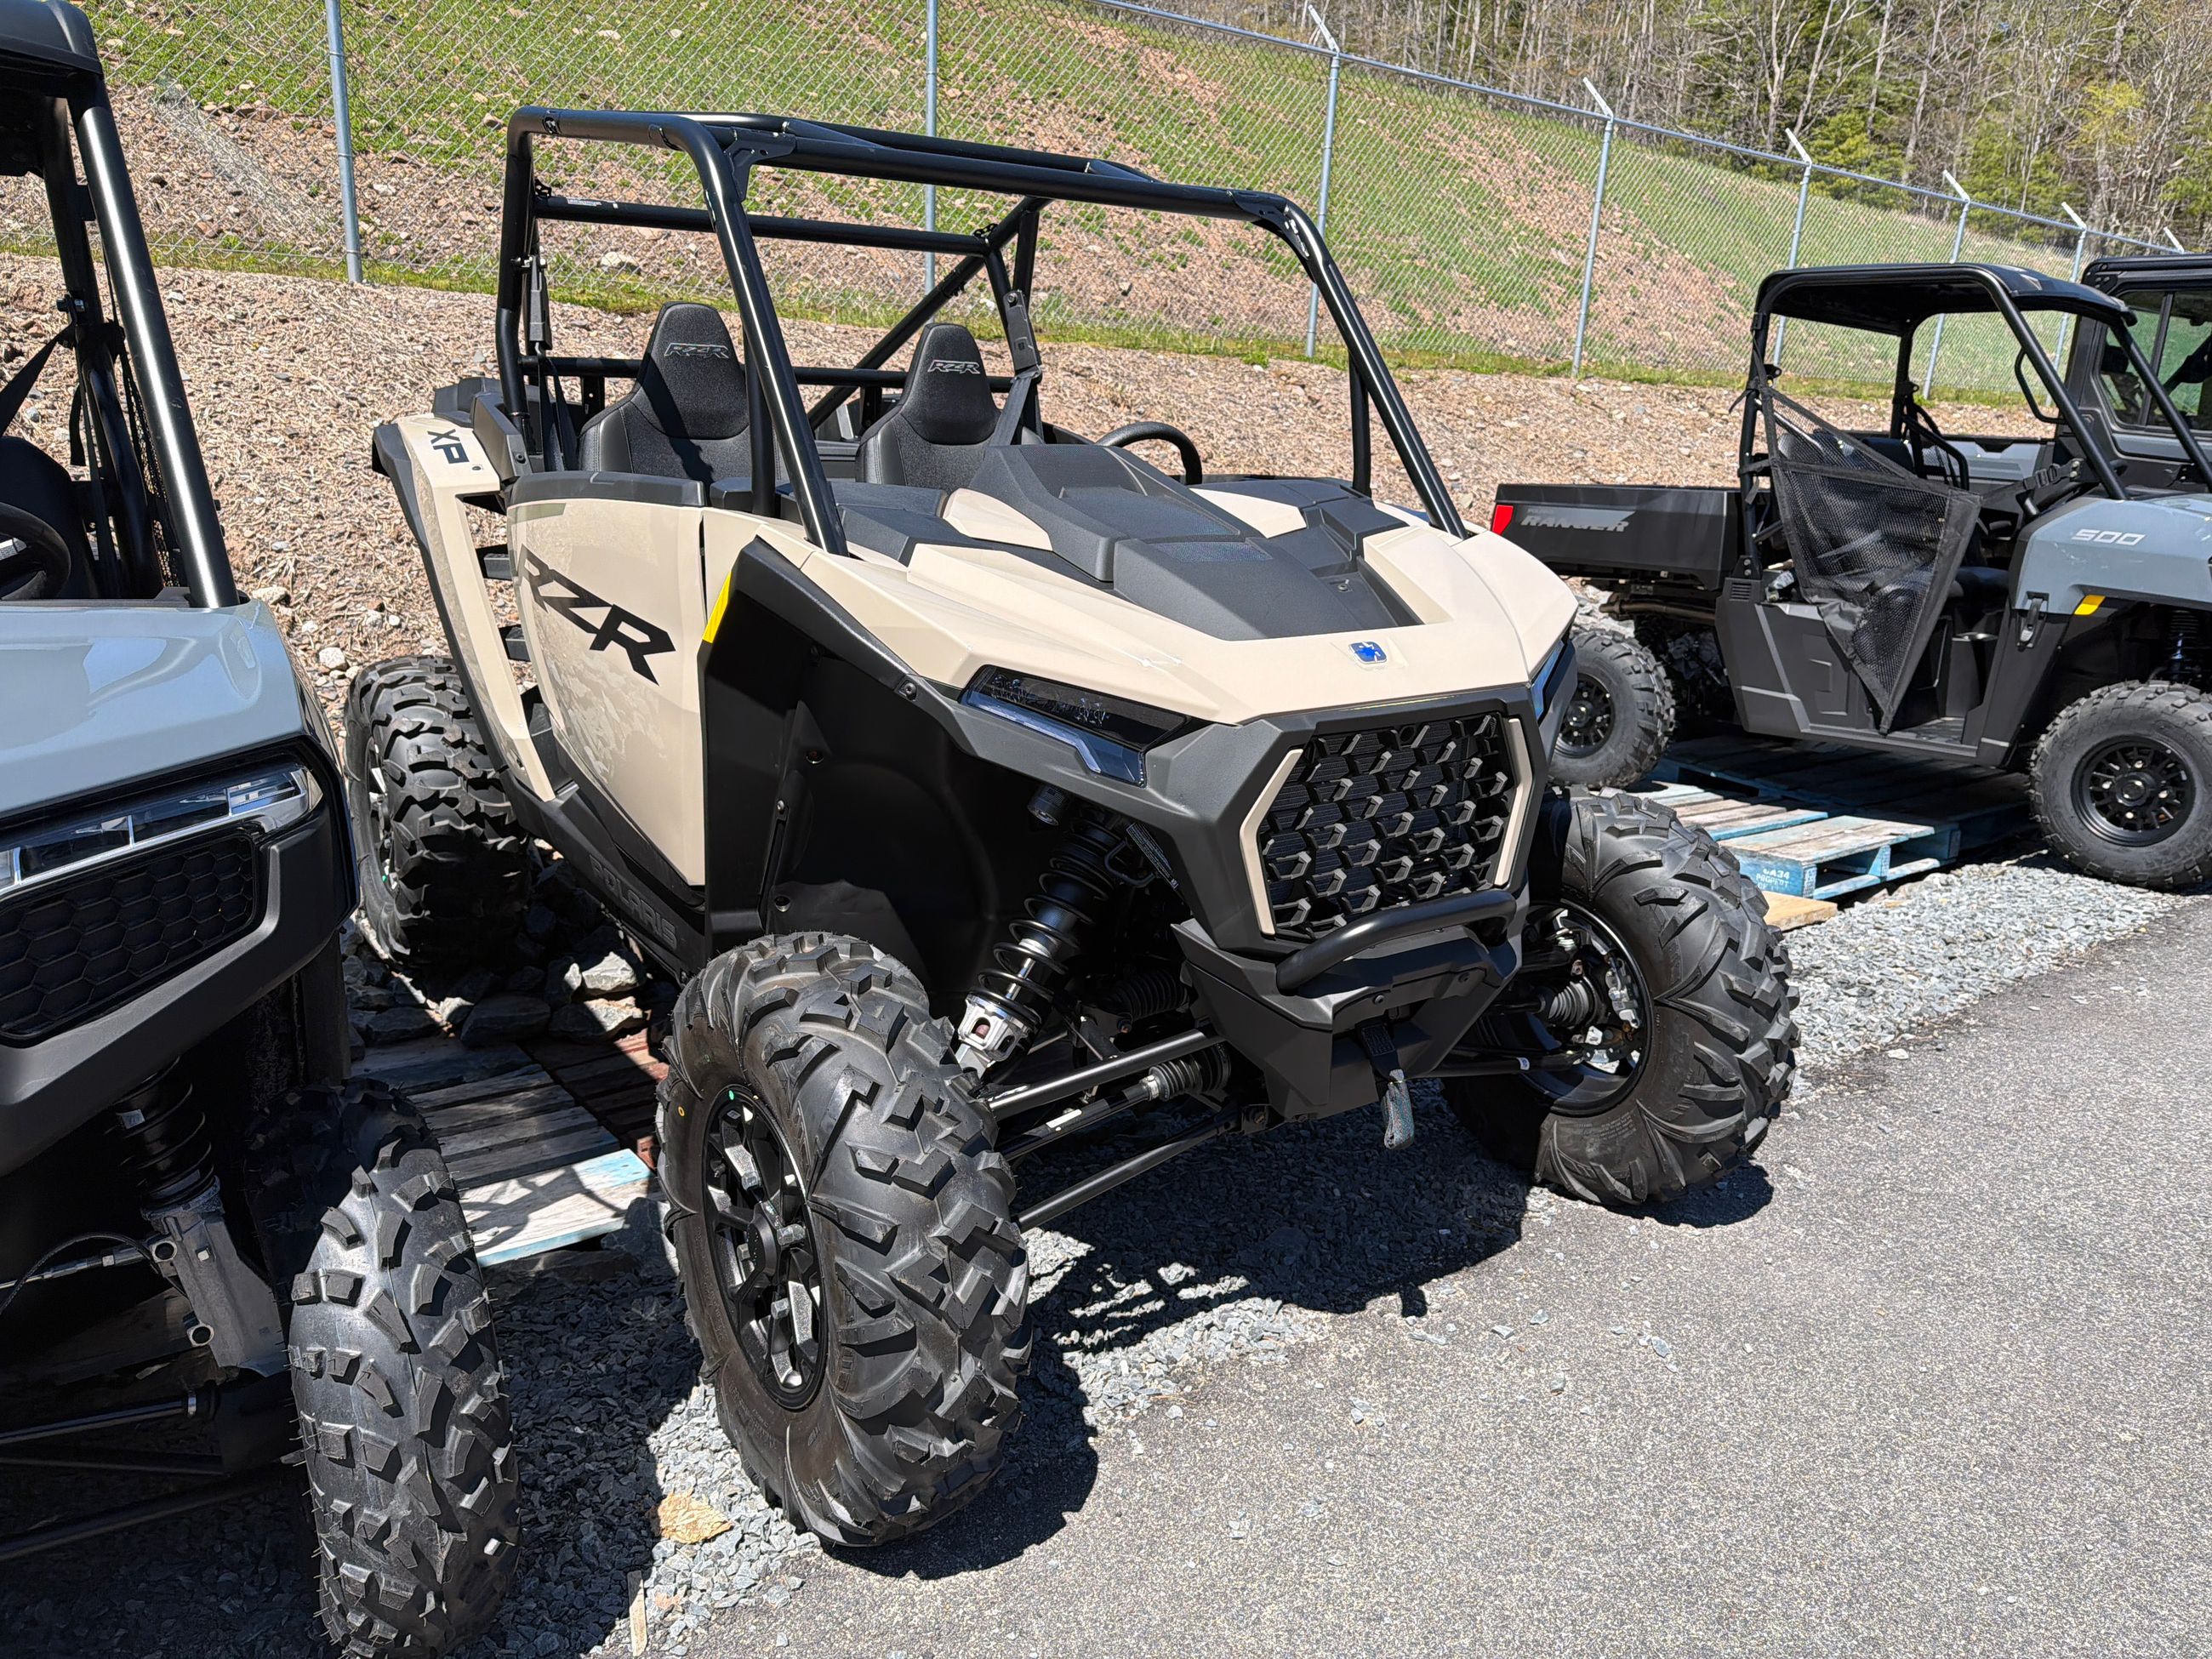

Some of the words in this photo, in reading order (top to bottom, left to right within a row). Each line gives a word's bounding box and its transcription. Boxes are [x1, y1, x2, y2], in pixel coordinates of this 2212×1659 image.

[664, 342, 729, 359] RZR
[927, 359, 981, 374] RZR
[428, 429, 468, 465] XP
[2071, 528, 2146, 546] 500
[516, 544, 676, 687] RZR
[589, 854, 677, 950] POLARIS
